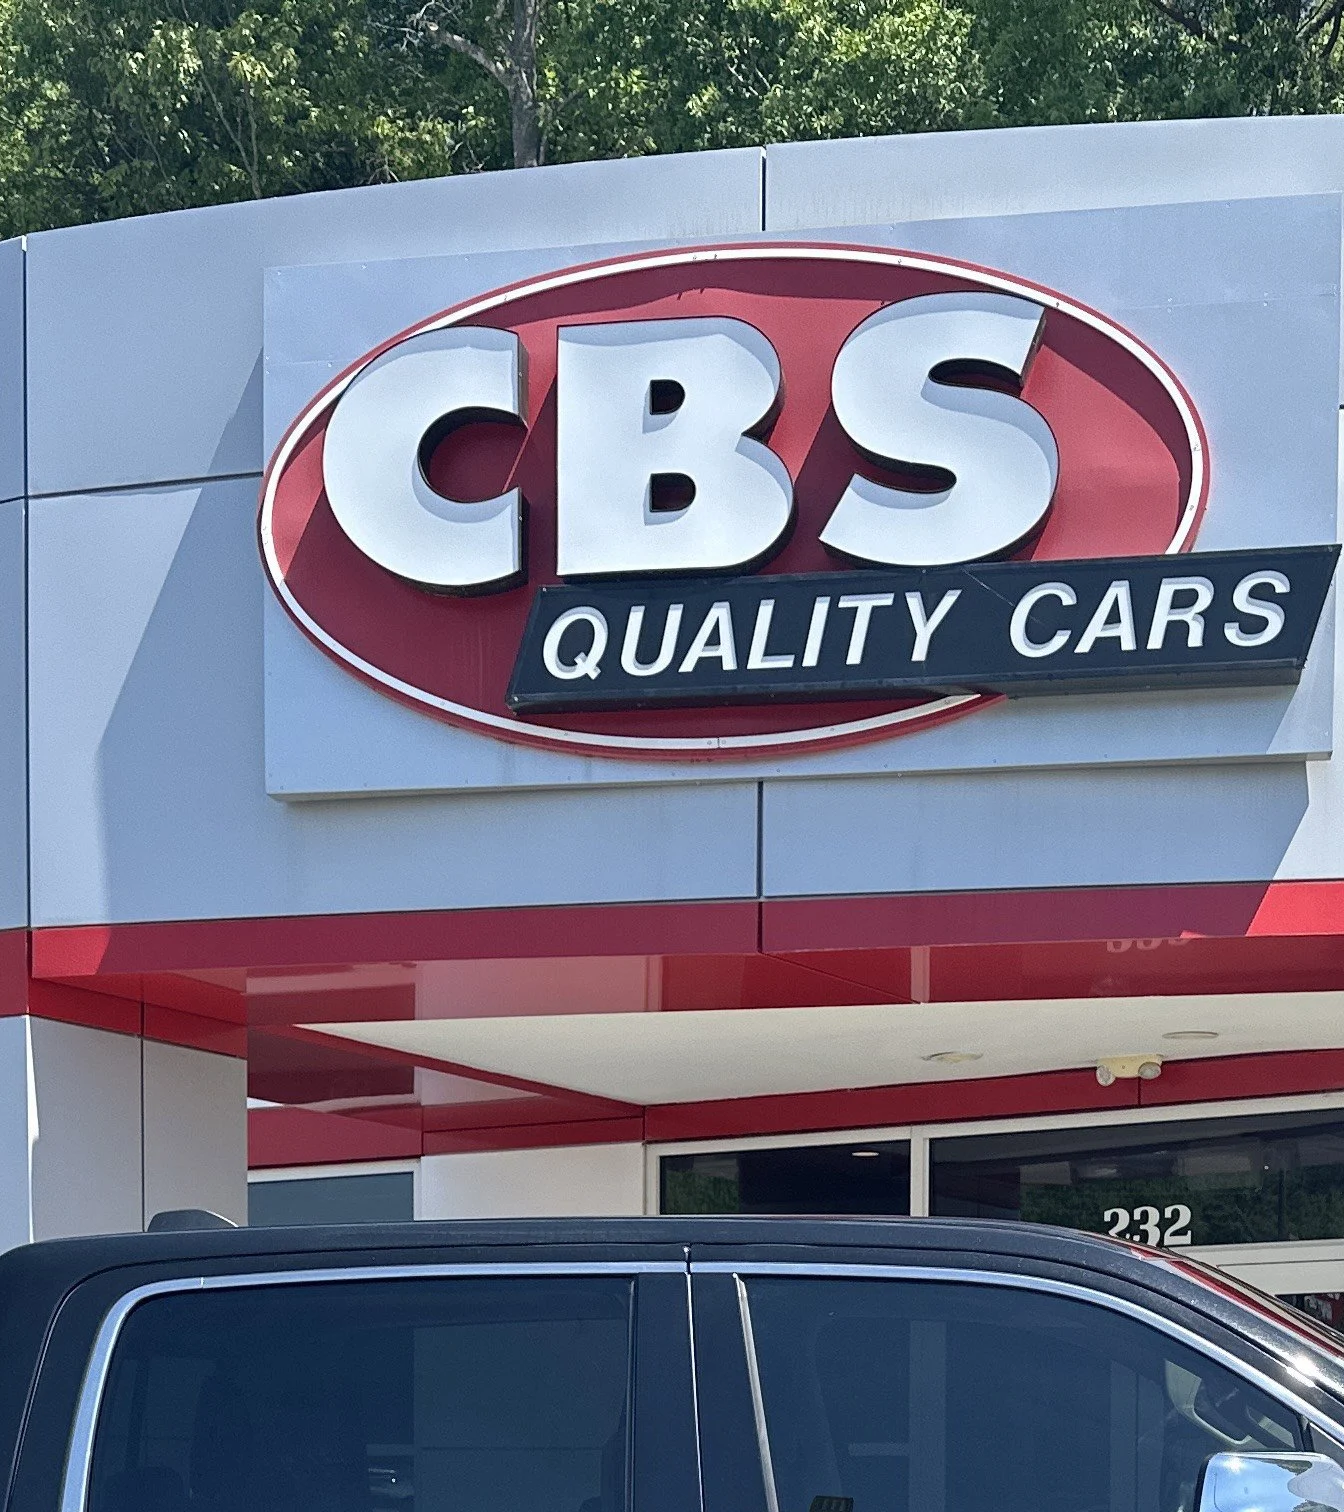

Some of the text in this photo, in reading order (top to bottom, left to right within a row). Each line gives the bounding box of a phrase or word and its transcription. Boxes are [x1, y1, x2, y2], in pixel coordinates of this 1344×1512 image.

[321, 290, 1061, 592] CBS
[542, 567, 1294, 681] QUALITY CARS
[1102, 1204, 1192, 1247] 232
